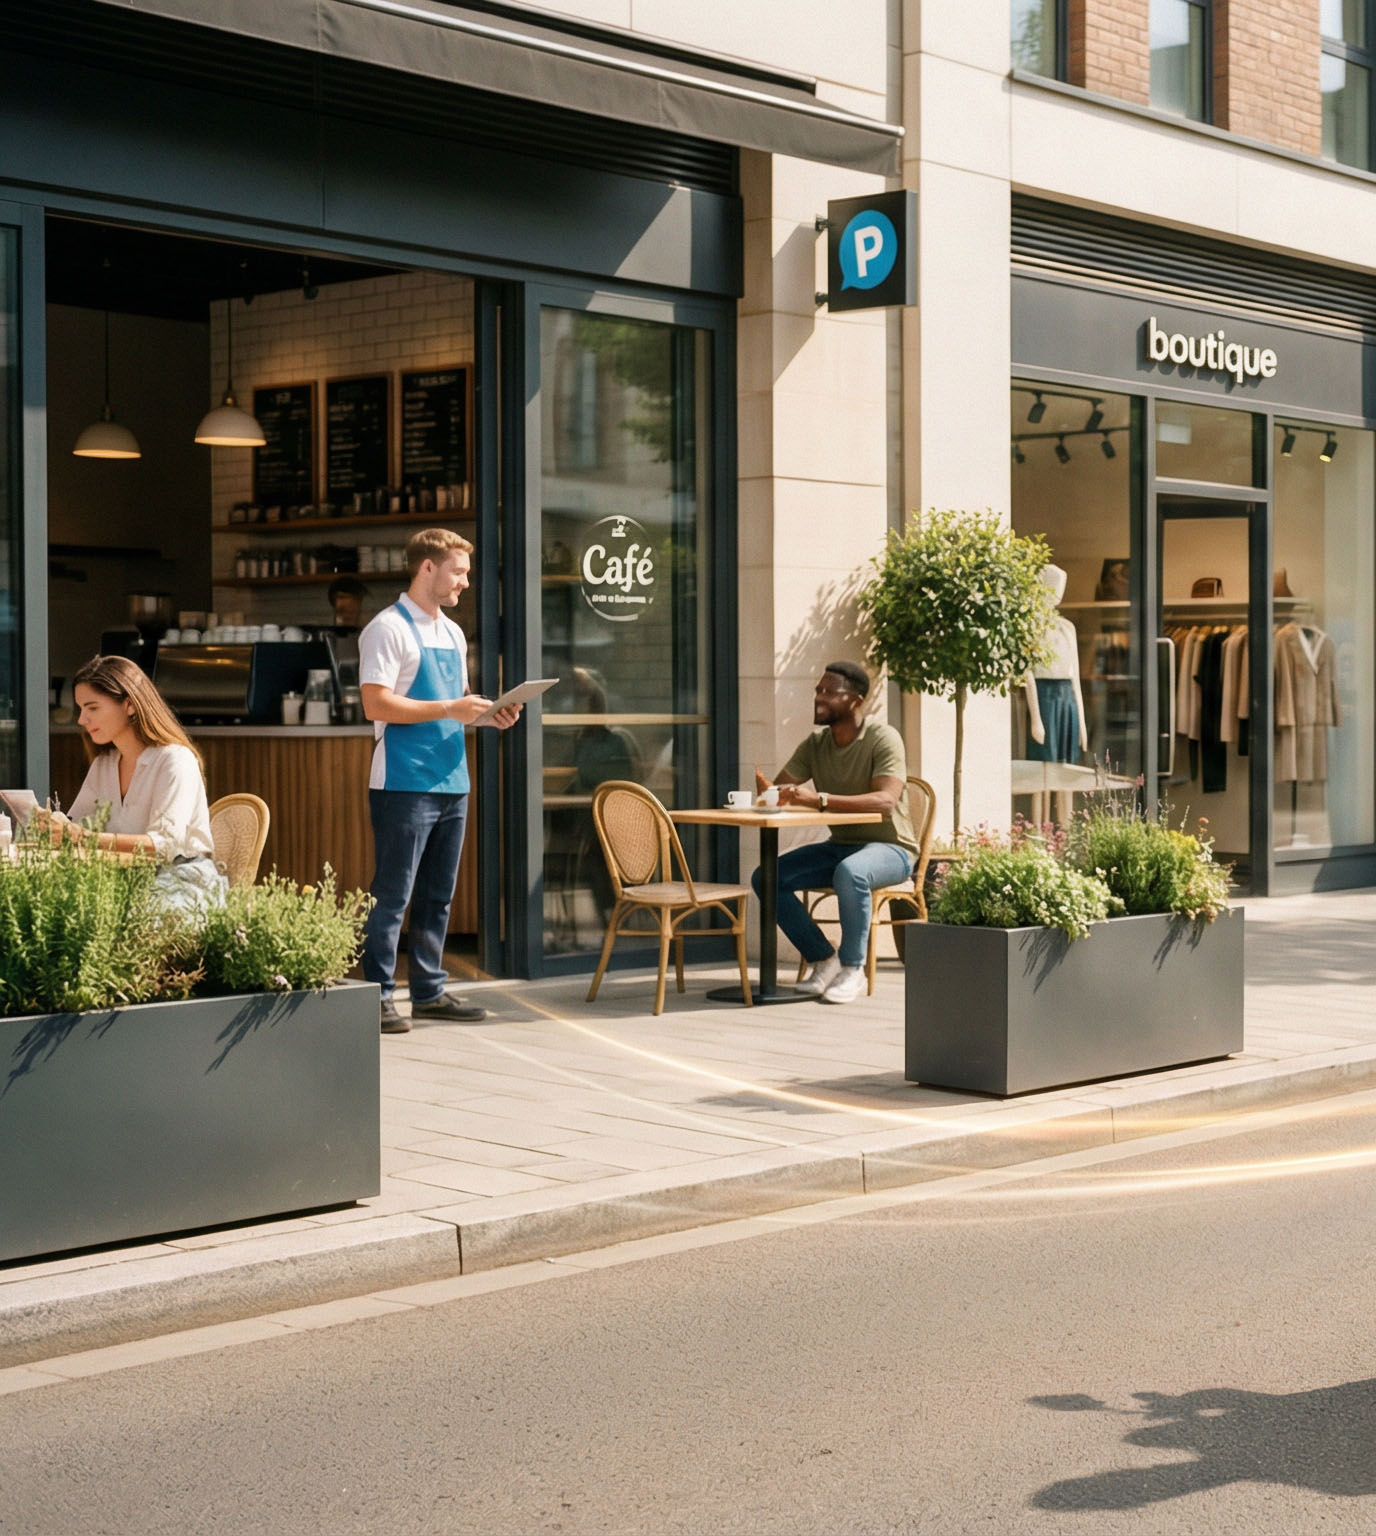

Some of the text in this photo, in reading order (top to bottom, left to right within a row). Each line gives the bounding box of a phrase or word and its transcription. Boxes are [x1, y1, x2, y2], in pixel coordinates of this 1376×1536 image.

[853, 225, 884, 278] P
[1150, 316, 1278, 384] boutique
[582, 543, 655, 593] Café
